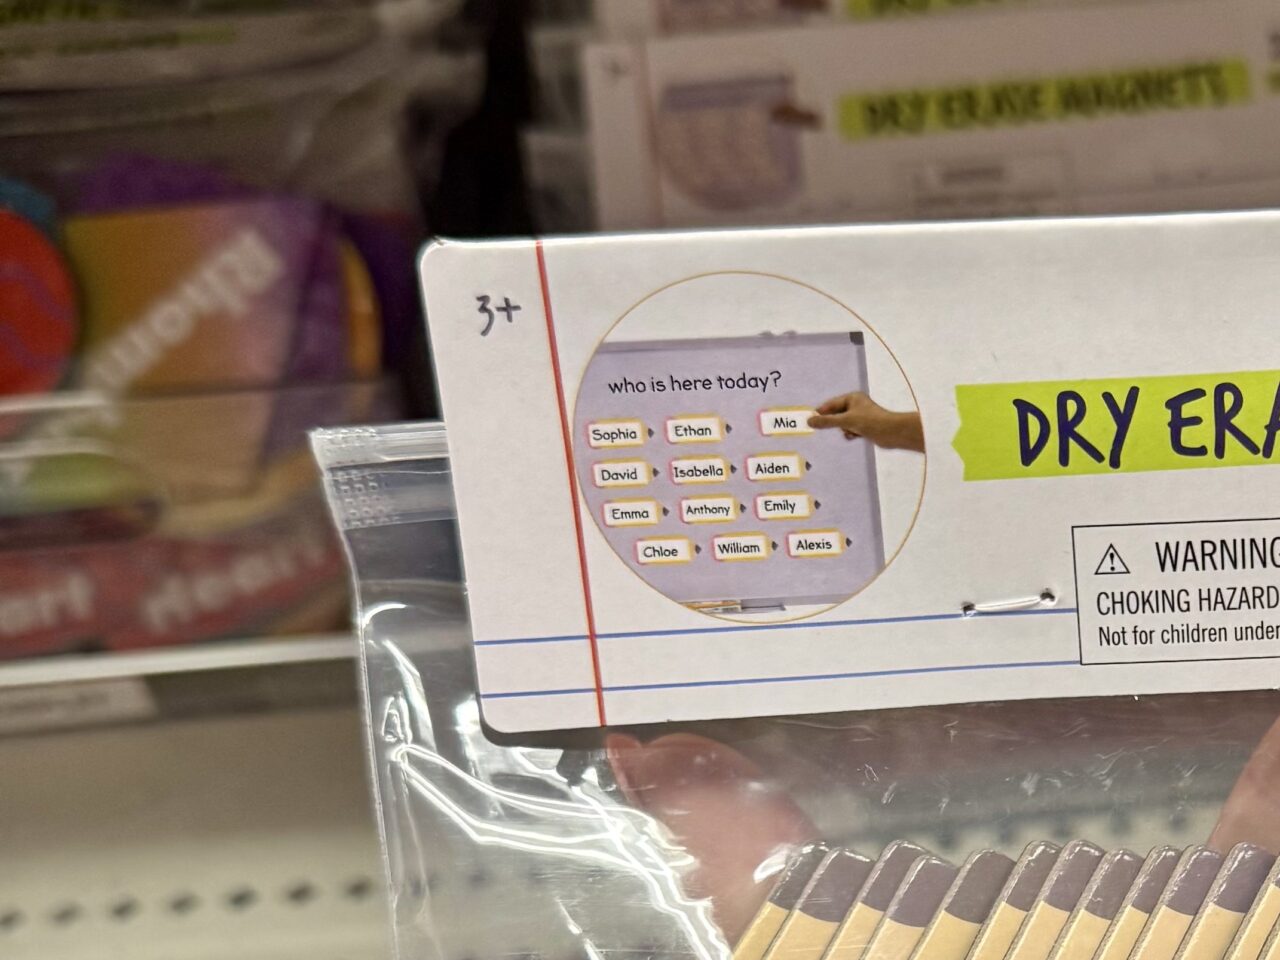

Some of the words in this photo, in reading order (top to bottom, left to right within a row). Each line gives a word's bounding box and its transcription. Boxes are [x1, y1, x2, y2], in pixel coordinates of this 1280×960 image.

[476, 294, 522, 337] 3+
[608, 376, 647, 394] who
[651, 375, 667, 392] is
[670, 375, 712, 392] here
[717, 370, 782, 393] today?
[773, 417, 797, 429] Mia
[1012, 385, 1140, 470] DRY
[592, 428, 637, 443] Sophia
[674, 424, 712, 437] Ethan
[601, 468, 637, 481] David
[674, 464, 724, 477] Isabella
[755, 461, 790, 475] Aiden
[686, 504, 731, 517] Anthony
[764, 498, 796, 515] Emily
[612, 508, 649, 520] Emma
[643, 546, 678, 558] Chloe
[718, 541, 760, 554] William
[796, 538, 833, 552] Alexis
[1096, 588, 1191, 616] CHOKING
[1099, 625, 1128, 646] Not
[1132, 625, 1155, 645] for
[1160, 621, 1228, 644] children
